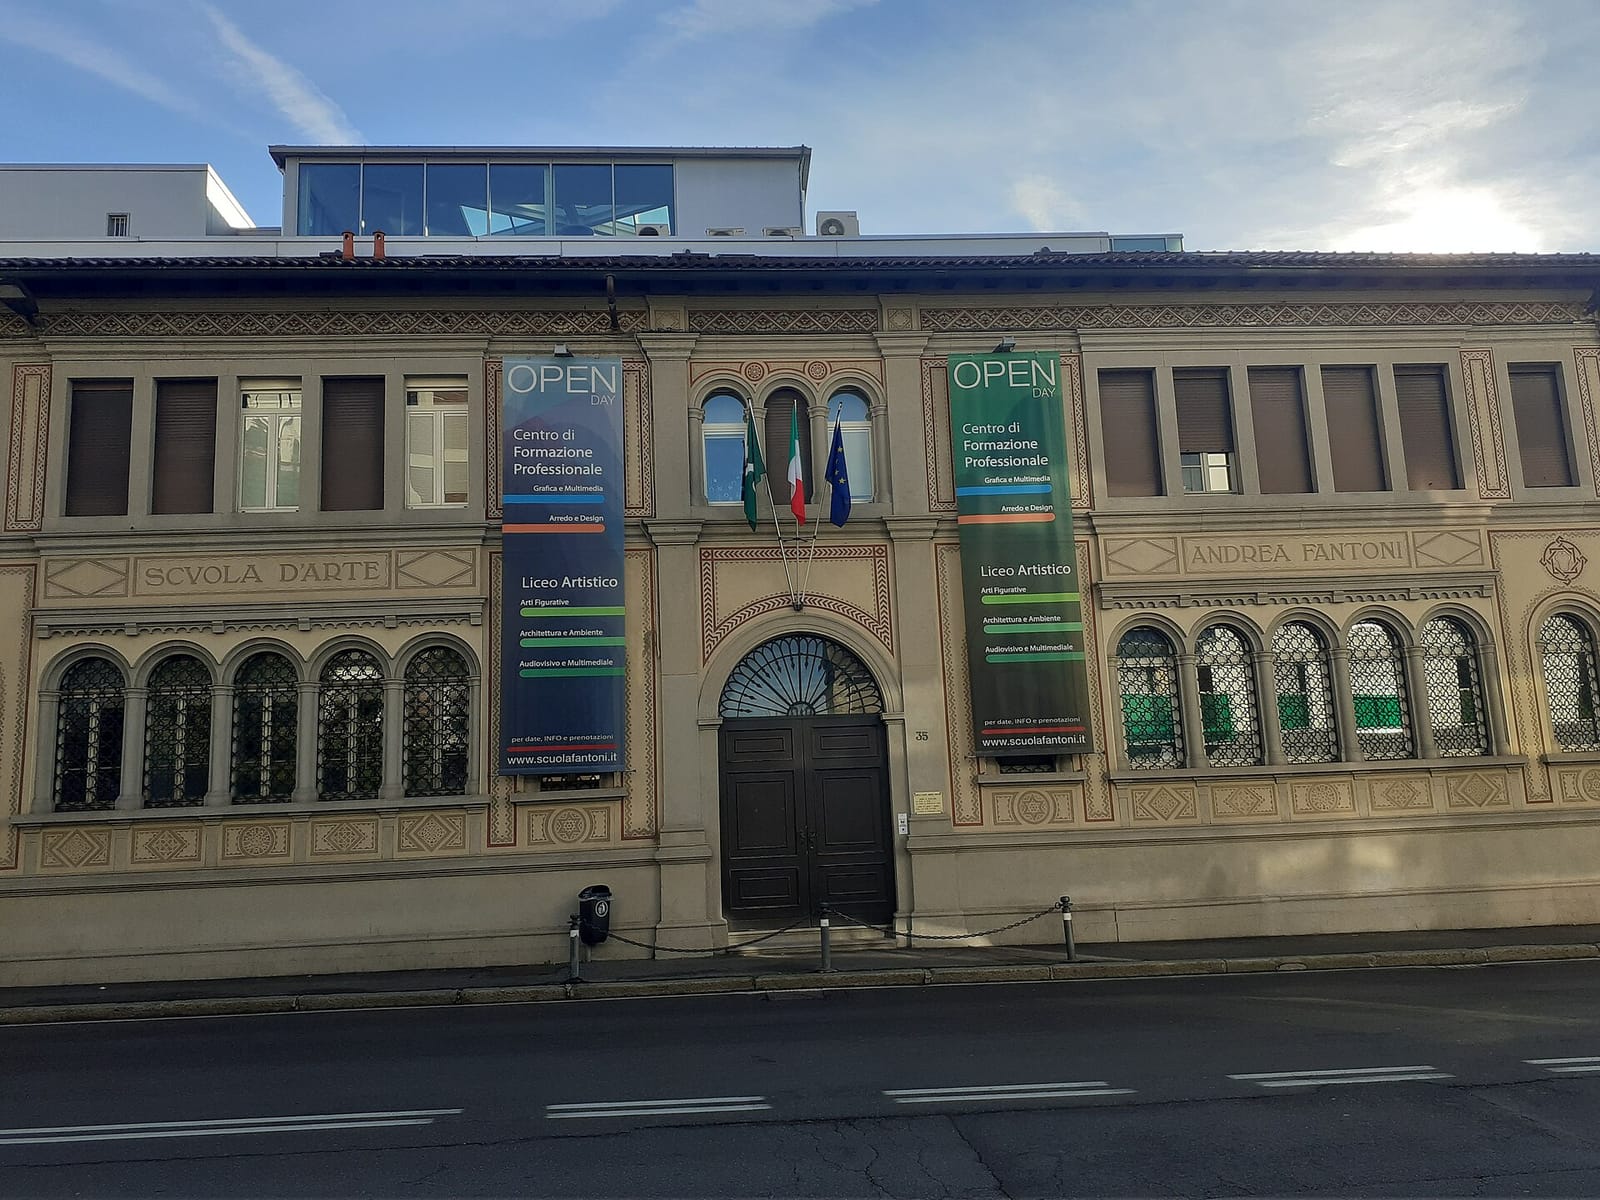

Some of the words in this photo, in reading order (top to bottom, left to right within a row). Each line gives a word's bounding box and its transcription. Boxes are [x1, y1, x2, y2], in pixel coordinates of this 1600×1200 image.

[507, 365, 616, 393] OPEN
[953, 360, 1056, 389] OPEN
[1032, 388, 1056, 398] DAY
[591, 395, 616, 406] DAY
[962, 423, 1005, 435] Centro
[1008, 422, 1020, 433] di
[513, 429, 559, 441] Centro
[562, 429, 575, 440] di
[963, 439, 1038, 451] Formazione
[513, 446, 593, 458] Formazione
[965, 454, 1049, 468] Professionale
[513, 463, 603, 475] Professionale
[984, 476, 1007, 484] Grafica
[1013, 475, 1051, 483] Multimedia
[564, 484, 604, 492] Multimedia
[1030, 504, 1054, 513] Design
[549, 514, 573, 522] Arredo
[580, 514, 604, 523] Design
[1191, 544, 1292, 564] ANDREA
[1302, 541, 1404, 562] FANTONI
[145, 564, 263, 587] SCVOLA
[279, 561, 381, 583] D'ARTE
[980, 566, 1014, 577] Liceo
[1018, 564, 1071, 576] Artistico
[522, 577, 558, 588] Liceo
[561, 576, 618, 588] Artistico
[994, 586, 1027, 595] Figurative
[534, 598, 570, 607] Figurative
[983, 616, 1022, 624] Architettura
[1028, 615, 1061, 623] Ambiente
[1029, 643, 1073, 652] Multimediale
[915, 731, 928, 741] 35
[982, 734, 1086, 747] www.scuolafantoni.it
[507, 752, 617, 765] www.scuolafantoni.it
